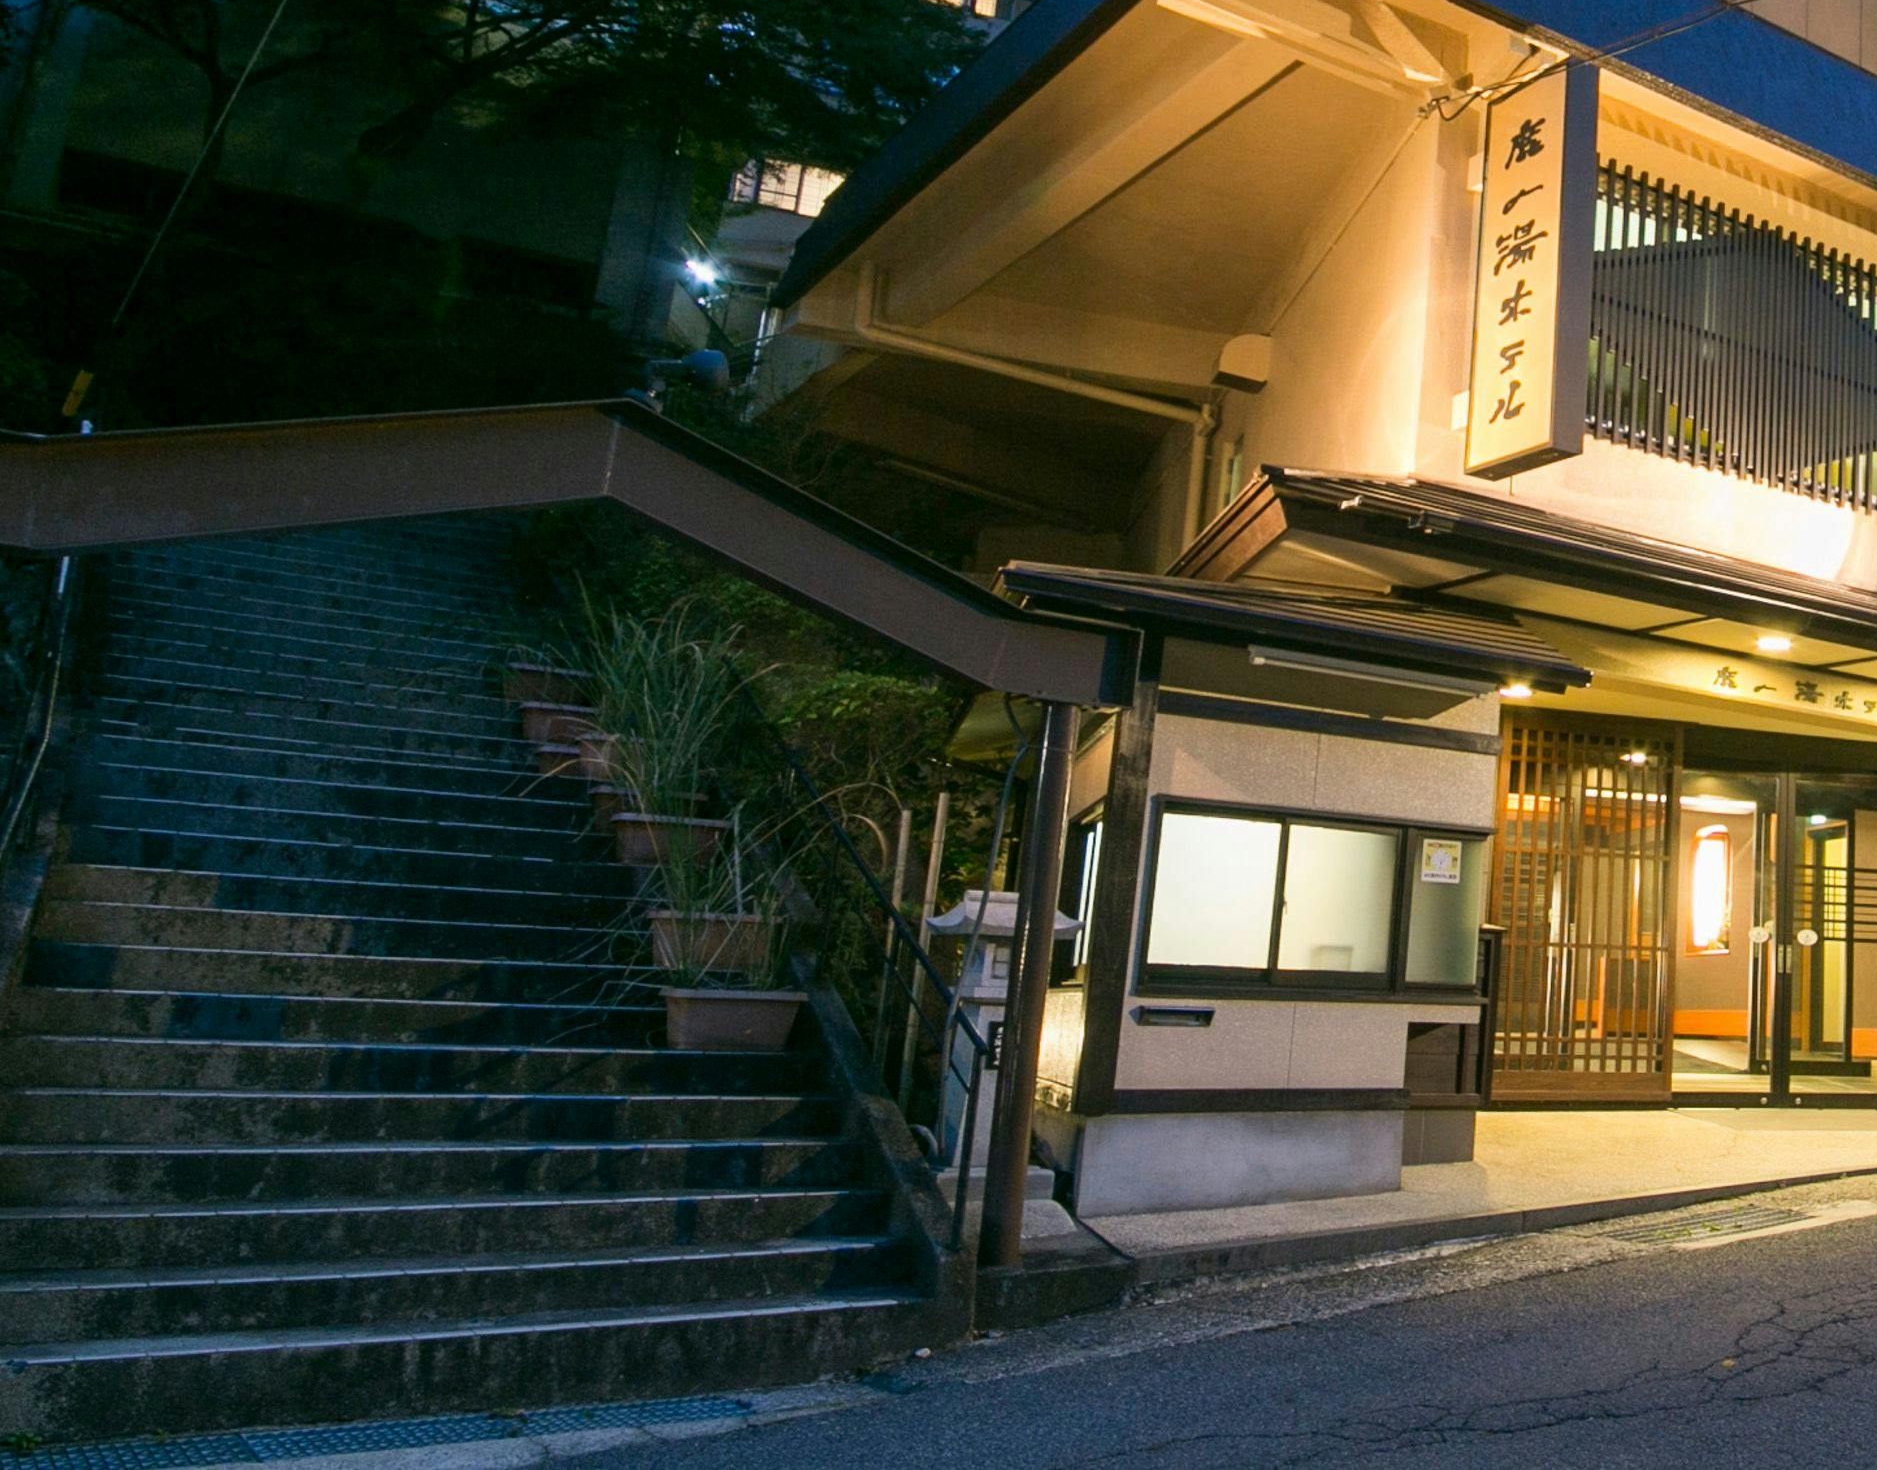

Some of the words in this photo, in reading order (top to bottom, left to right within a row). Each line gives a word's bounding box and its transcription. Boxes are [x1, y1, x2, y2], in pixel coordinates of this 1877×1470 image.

[1489, 118, 1549, 423] 鹿の湯ホテル
